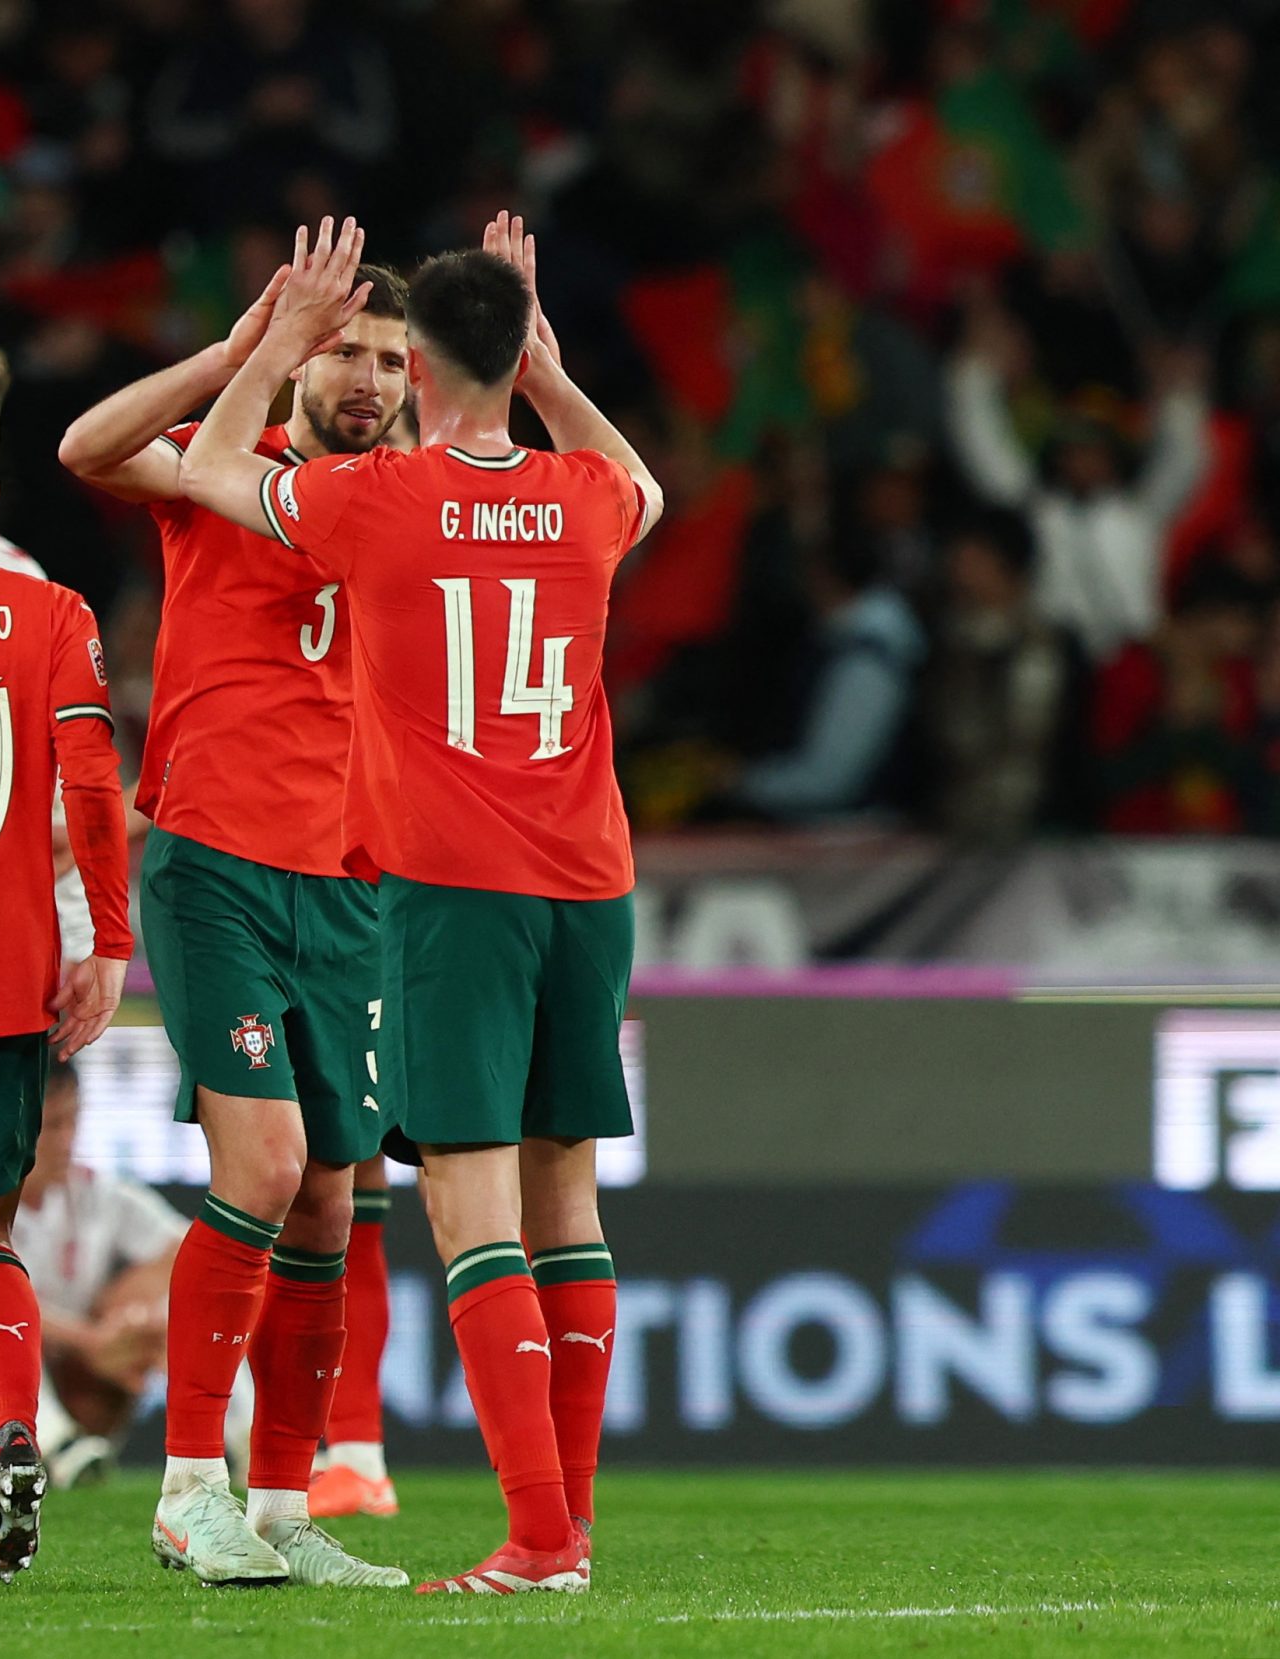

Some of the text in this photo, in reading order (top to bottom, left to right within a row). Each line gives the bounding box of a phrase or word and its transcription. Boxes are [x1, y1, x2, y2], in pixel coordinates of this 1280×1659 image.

[440, 497, 563, 541] G. INÁCIO
[431, 577, 575, 760] 14
